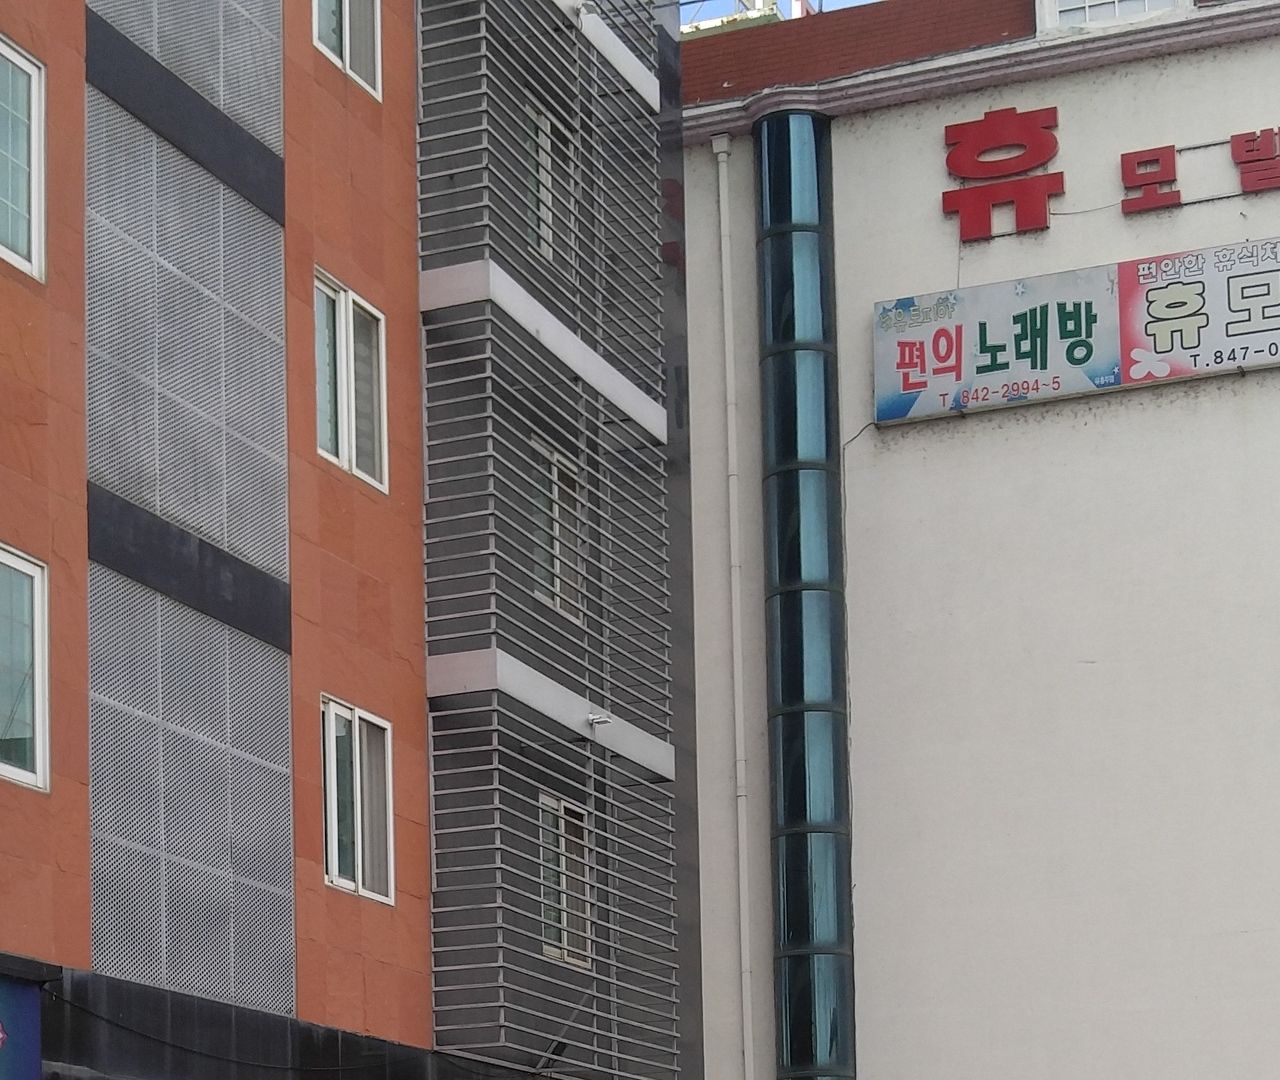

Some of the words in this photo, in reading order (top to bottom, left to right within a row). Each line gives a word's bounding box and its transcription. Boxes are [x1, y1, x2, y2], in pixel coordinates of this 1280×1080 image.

[942, 106, 1065, 242] 휴
[1136, 253, 1206, 285] 편안한
[895, 322, 964, 393] 편의
[975, 300, 1098, 376] 노래방
[1144, 280, 1210, 354] 휴
[961, 375, 1062, 406] 842-2994~5
